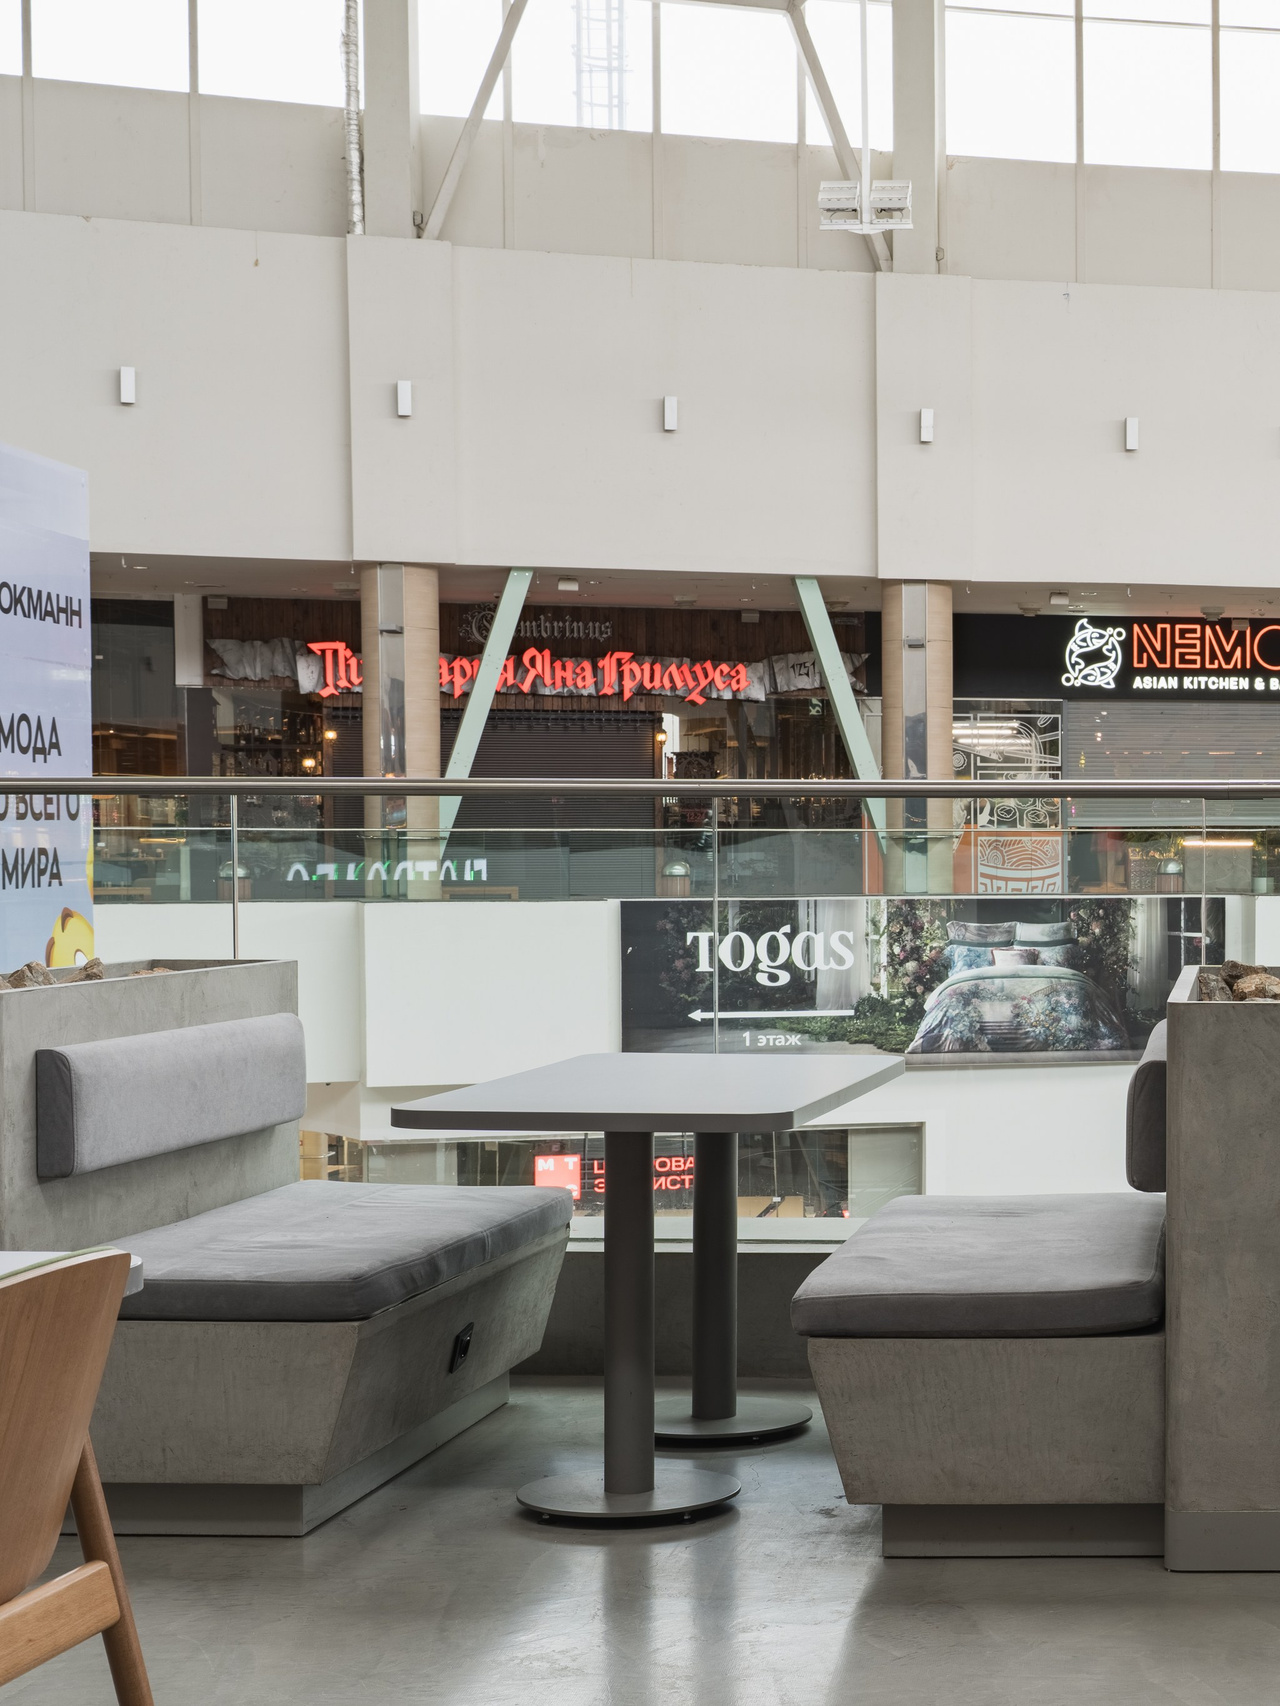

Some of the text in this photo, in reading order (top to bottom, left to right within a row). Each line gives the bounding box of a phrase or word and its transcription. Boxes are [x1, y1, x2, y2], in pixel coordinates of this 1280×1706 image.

[457, 602, 613, 643] Gmbrinus
[517, 647, 597, 694] Яна
[597, 651, 751, 706] Гримуса
[1133, 676, 1178, 689] ASIAN
[1183, 676, 1249, 690] KITCHEN
[1254, 677, 1265, 690] &
[0, 713, 62, 763] МОДА
[1, 847, 63, 890] МИРА
[742, 1031, 802, 1047] 1 этаж
